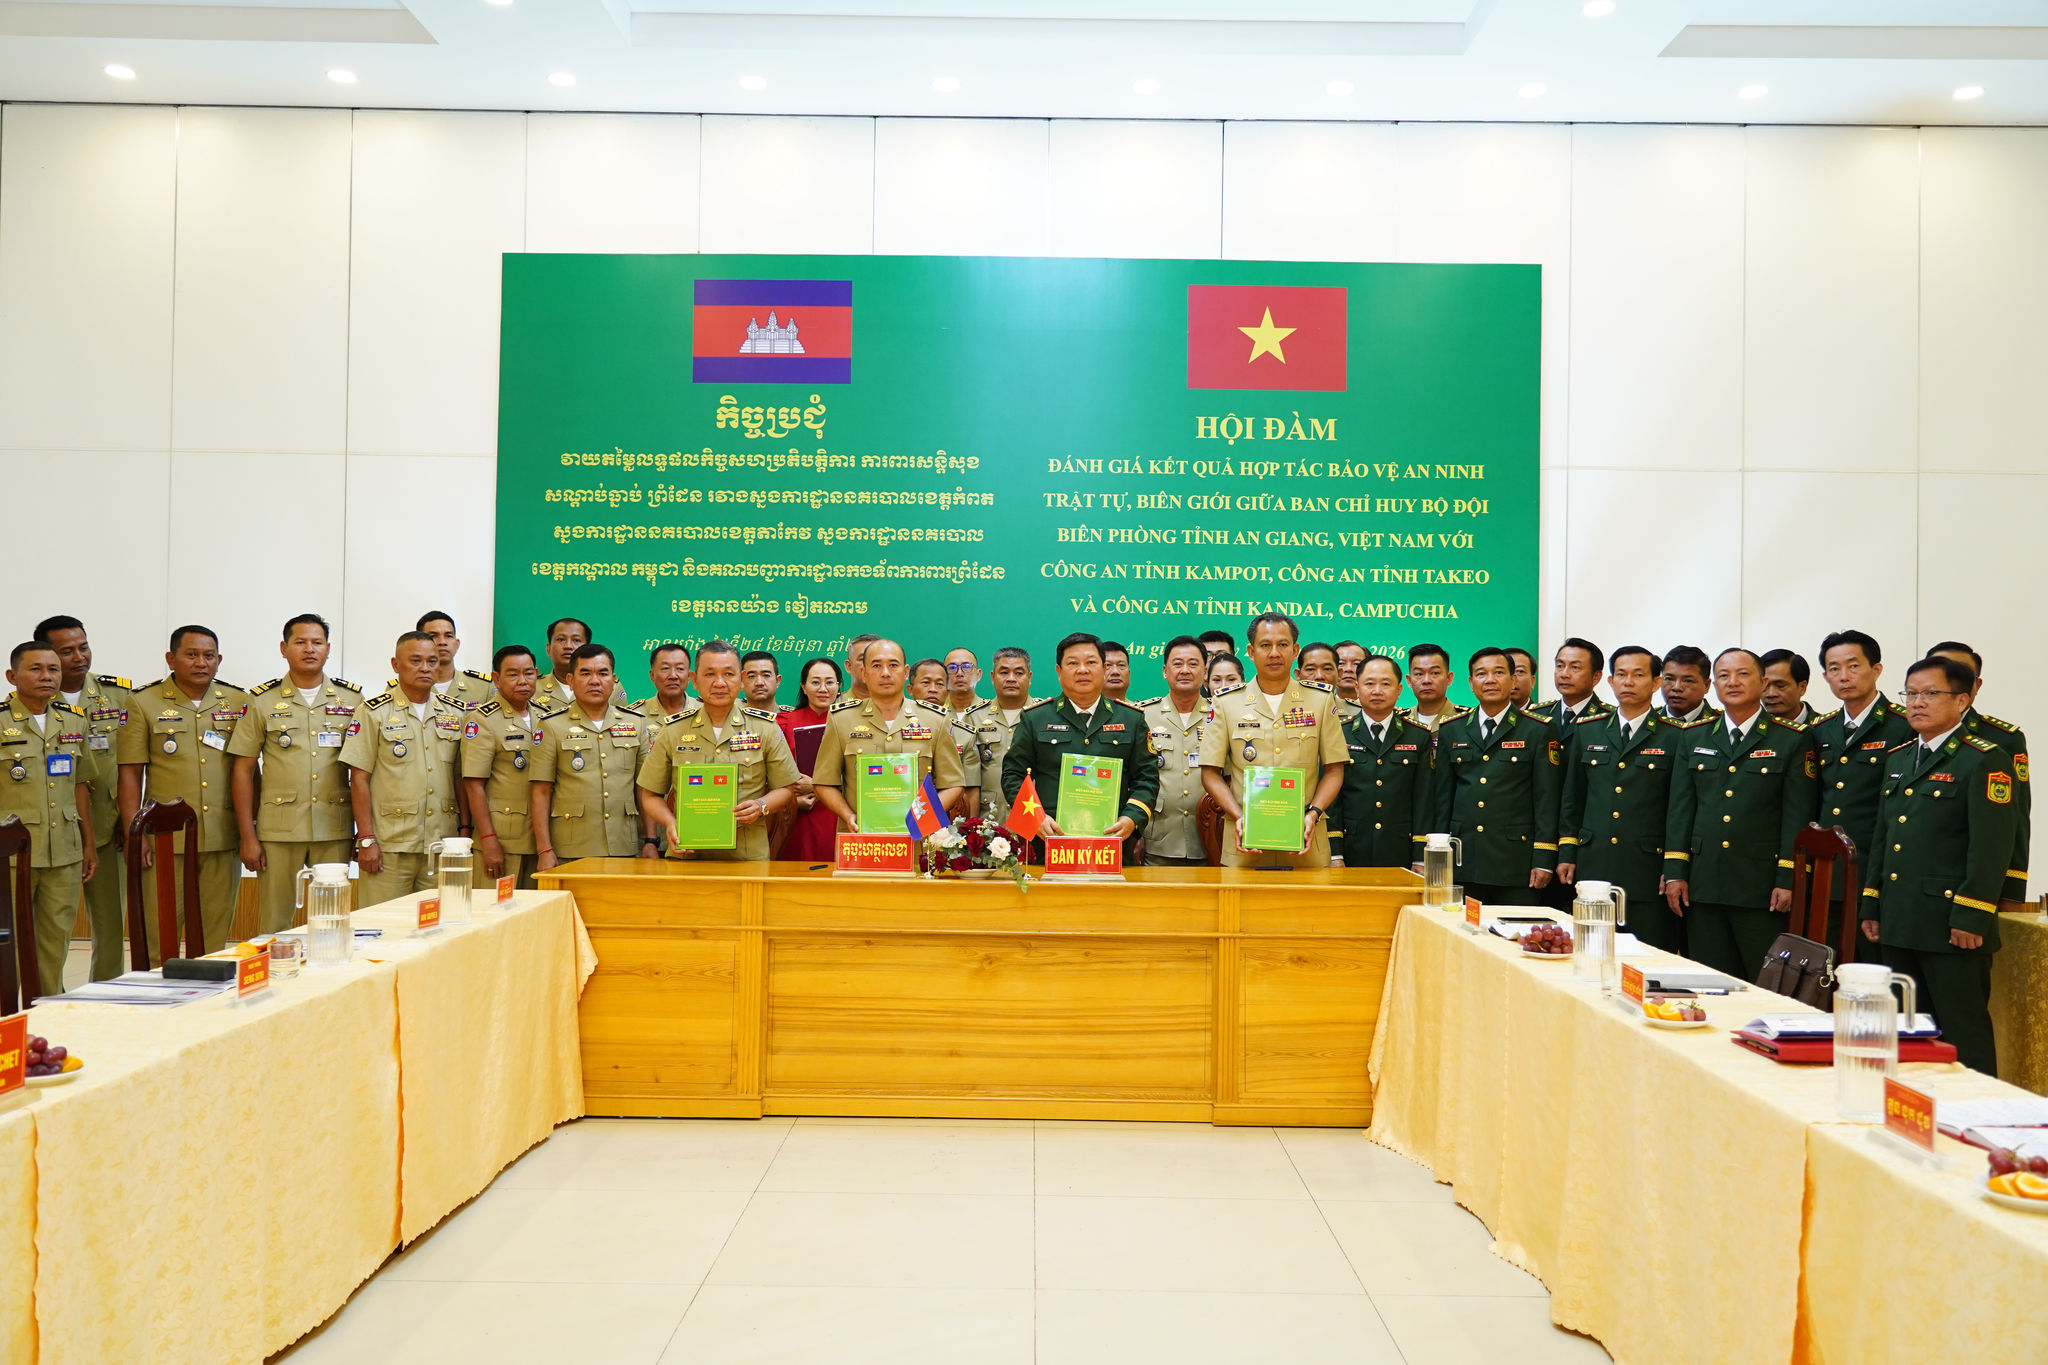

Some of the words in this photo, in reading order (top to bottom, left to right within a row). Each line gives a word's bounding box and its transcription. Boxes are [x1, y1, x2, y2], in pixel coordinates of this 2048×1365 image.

[715, 394, 826, 439] កិច្ចប្រជុំ
[1196, 413, 1255, 445] HỘI
[1264, 411, 1337, 440] ĐÀM
[1048, 455, 1103, 473] ĐÁNH
[1108, 456, 1144, 474] GIÁ
[1149, 456, 1188, 474] KẾT
[1193, 457, 1234, 478] QUẢ
[1240, 458, 1280, 479] HỢP
[1284, 458, 1322, 477] TÁC
[1328, 459, 1369, 478] BẢO
[1373, 462, 1399, 482] VỆ
[1403, 464, 1430, 478] AN
[1435, 465, 1484, 479] NINH
[1043, 491, 1095, 511] TRẬT
[1099, 492, 1131, 512] TỰ,
[1136, 491, 1182, 509] BIÊN
[1187, 492, 1231, 509] GIỚI
[1236, 493, 1286, 511] GIỮA
[1290, 497, 1330, 511] BAN
[1335, 494, 1370, 512] CHỈ
[1375, 499, 1417, 512] HUY
[1421, 497, 1448, 517] BỘ
[1453, 497, 1488, 517] ĐỘI
[1057, 524, 1103, 542] BIÊN
[1108, 525, 1176, 543] PHÒNG
[1181, 526, 1229, 544] TỈNH
[1233, 531, 1260, 545] AN
[1265, 531, 1333, 549] GIANG,
[1338, 529, 1384, 550] VIỆT
[1389, 533, 1434, 548] NAM
[1438, 530, 1474, 548] VỚI
[1041, 560, 1096, 578] CÔNG
[1100, 564, 1128, 578] AN
[1132, 561, 1180, 579] TỈNH
[1185, 566, 1273, 584] KAMPOT,
[1278, 563, 1334, 582] CÔNG
[1338, 567, 1366, 582] AN
[1370, 565, 1418, 583] TỈNH
[1423, 569, 1489, 584] TAKEO
[1070, 595, 1097, 613] VÀ
[1102, 595, 1158, 614] CÔNG
[1162, 600, 1190, 614] AN
[1194, 597, 1242, 615] TỈNH
[1247, 601, 1334, 620] KANDAL,
[1339, 603, 1459, 618] CAMPUCHIA
[1126, 642, 1145, 655] An
[1370, 645, 1406, 660] 2026
[1051, 846, 1075, 865] BÀN
[1077, 846, 1092, 865] KÝ
[1095, 845, 1116, 865] KẾT
